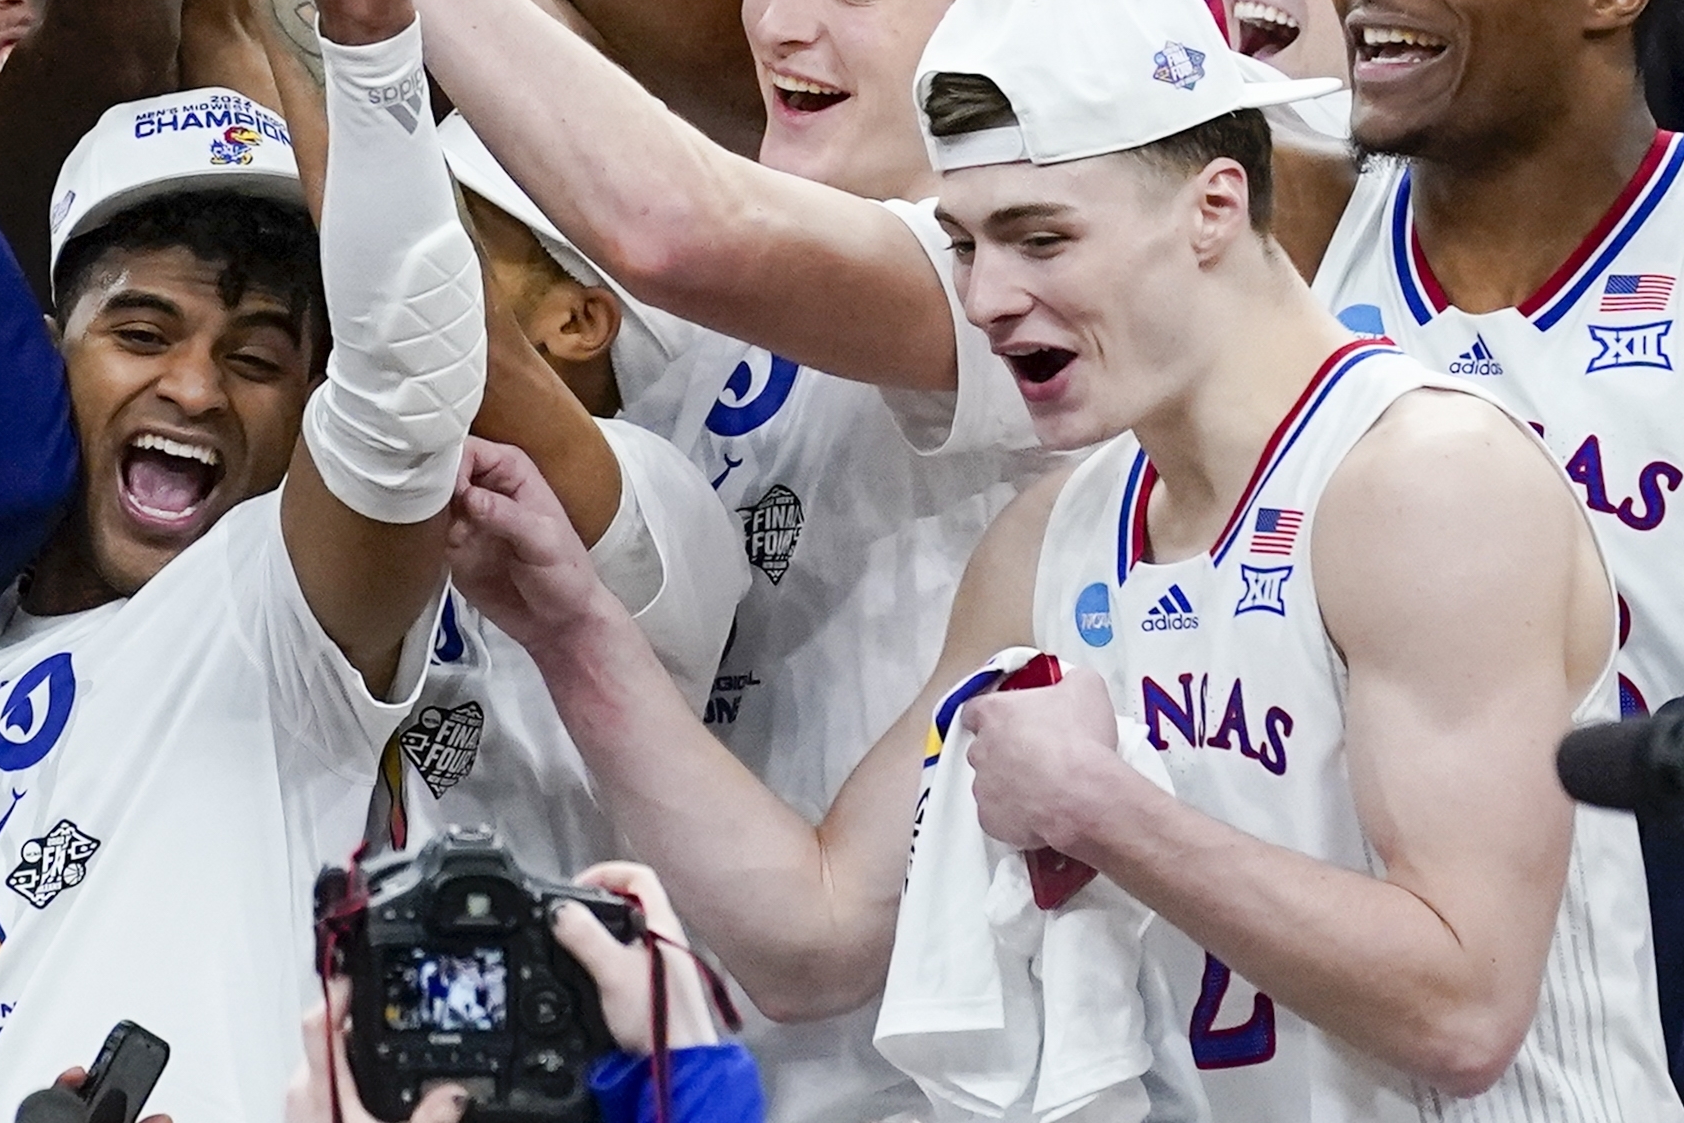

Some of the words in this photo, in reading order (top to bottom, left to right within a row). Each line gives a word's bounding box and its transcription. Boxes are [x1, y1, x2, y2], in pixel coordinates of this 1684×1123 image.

[209, 95, 252, 109] 2022
[135, 106, 179, 122] MEN'S
[182, 103, 251, 114] MIDWEST
[1449, 359, 1504, 376] adidas
[1141, 613, 1199, 632] adidas
